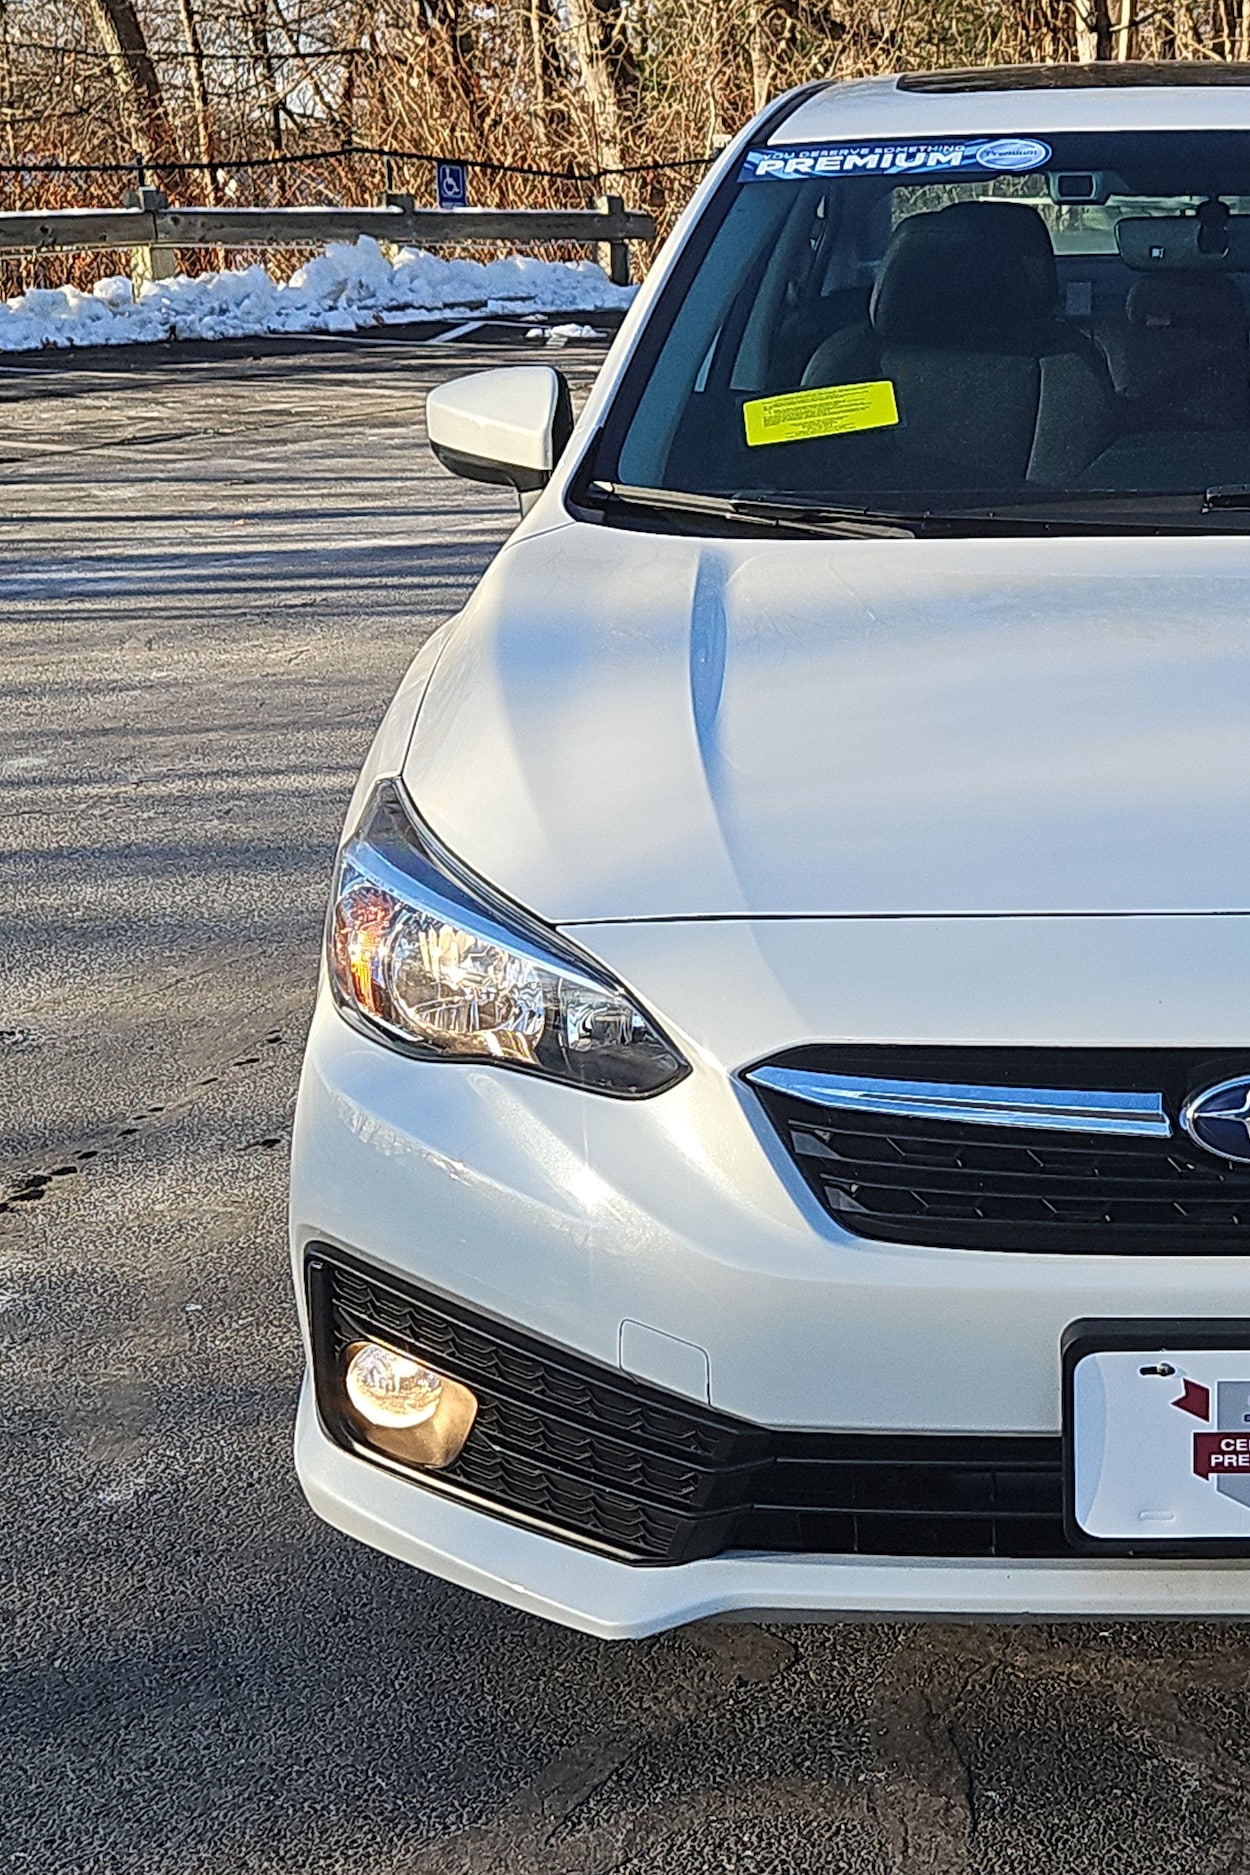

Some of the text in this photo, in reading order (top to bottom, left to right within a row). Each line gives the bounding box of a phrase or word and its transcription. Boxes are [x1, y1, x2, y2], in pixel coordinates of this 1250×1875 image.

[762, 145, 966, 160] YOU DESERVE SOMETHING
[755, 151, 964, 175] PREMIUM
